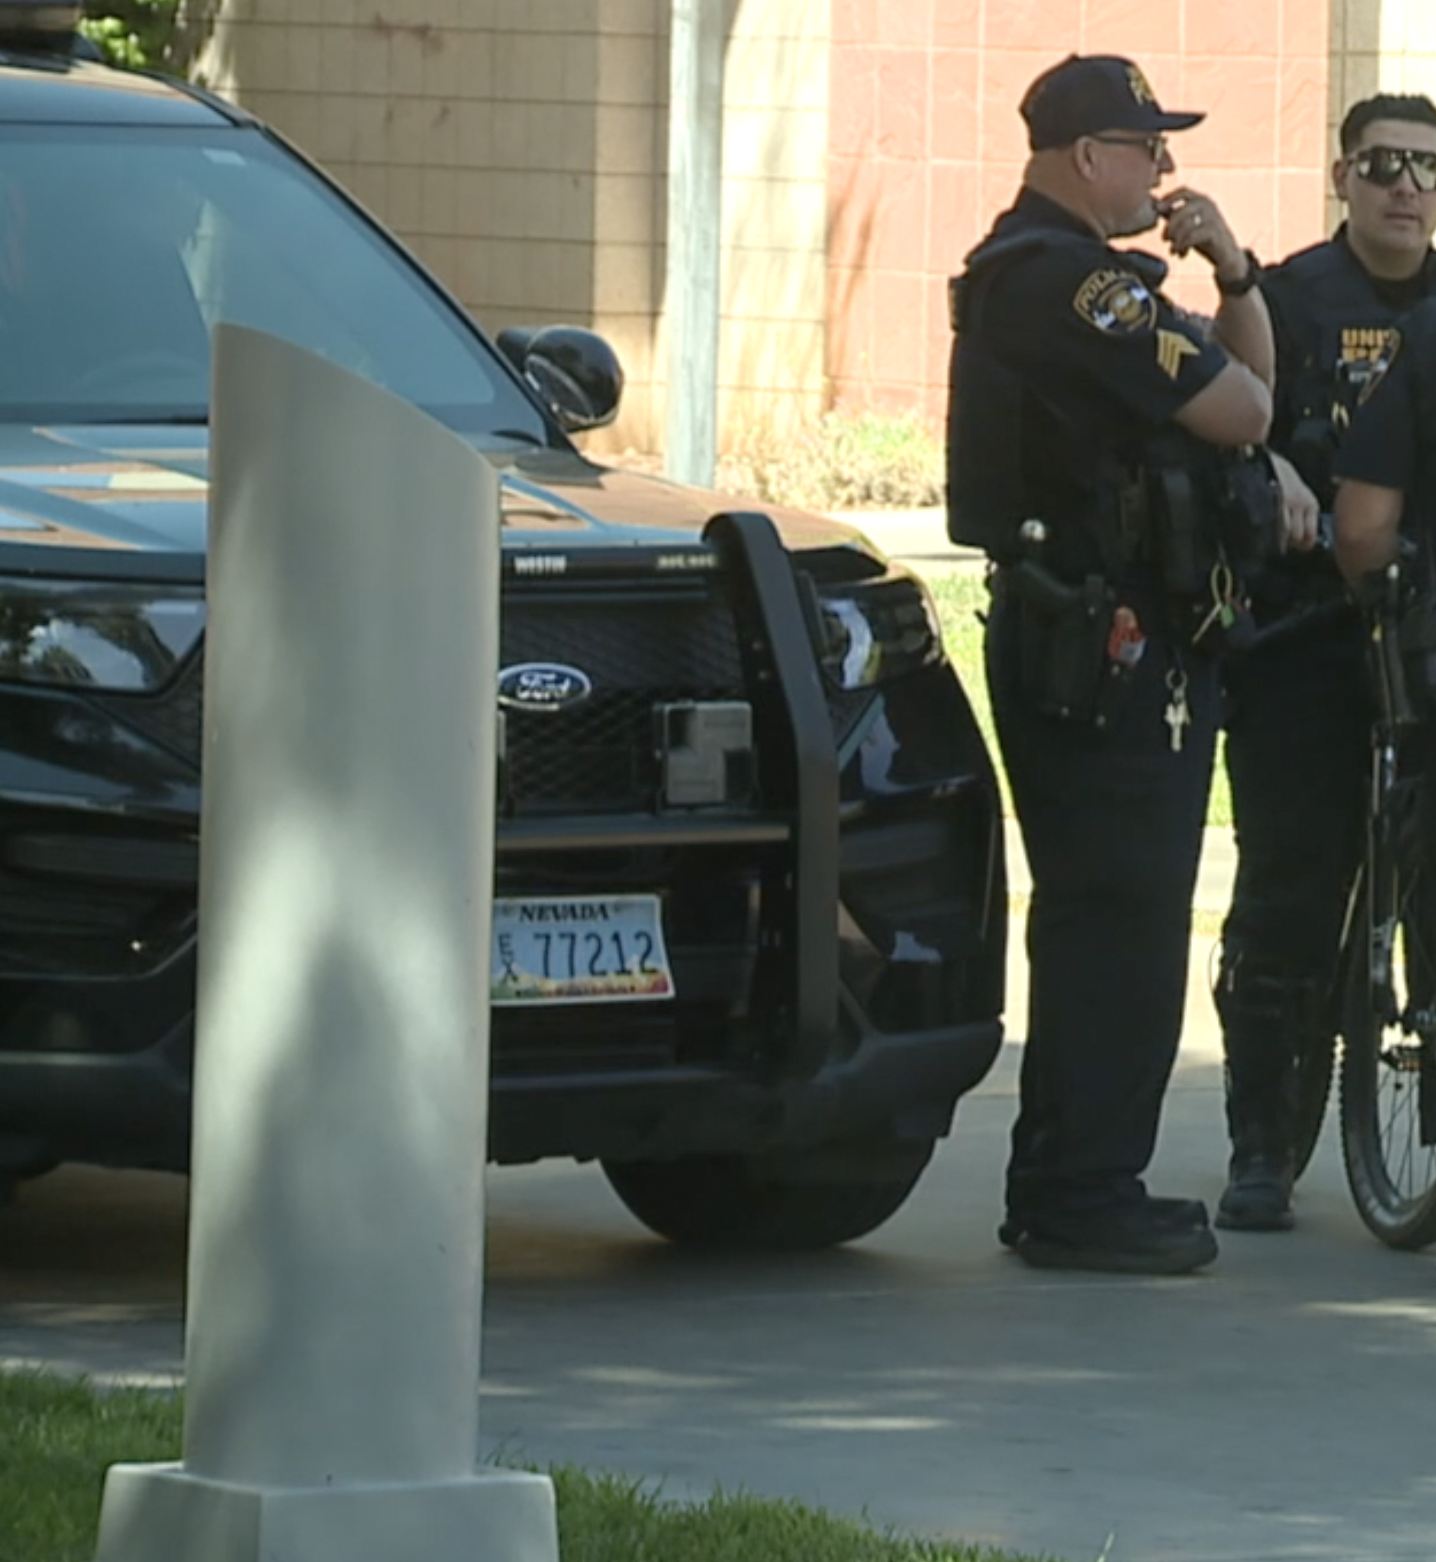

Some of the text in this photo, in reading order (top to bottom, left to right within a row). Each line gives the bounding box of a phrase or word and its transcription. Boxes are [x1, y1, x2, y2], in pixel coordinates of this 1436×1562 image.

[516, 672, 572, 700] Ford
[520, 903, 609, 923] NEVADA
[534, 930, 657, 979] 77212
